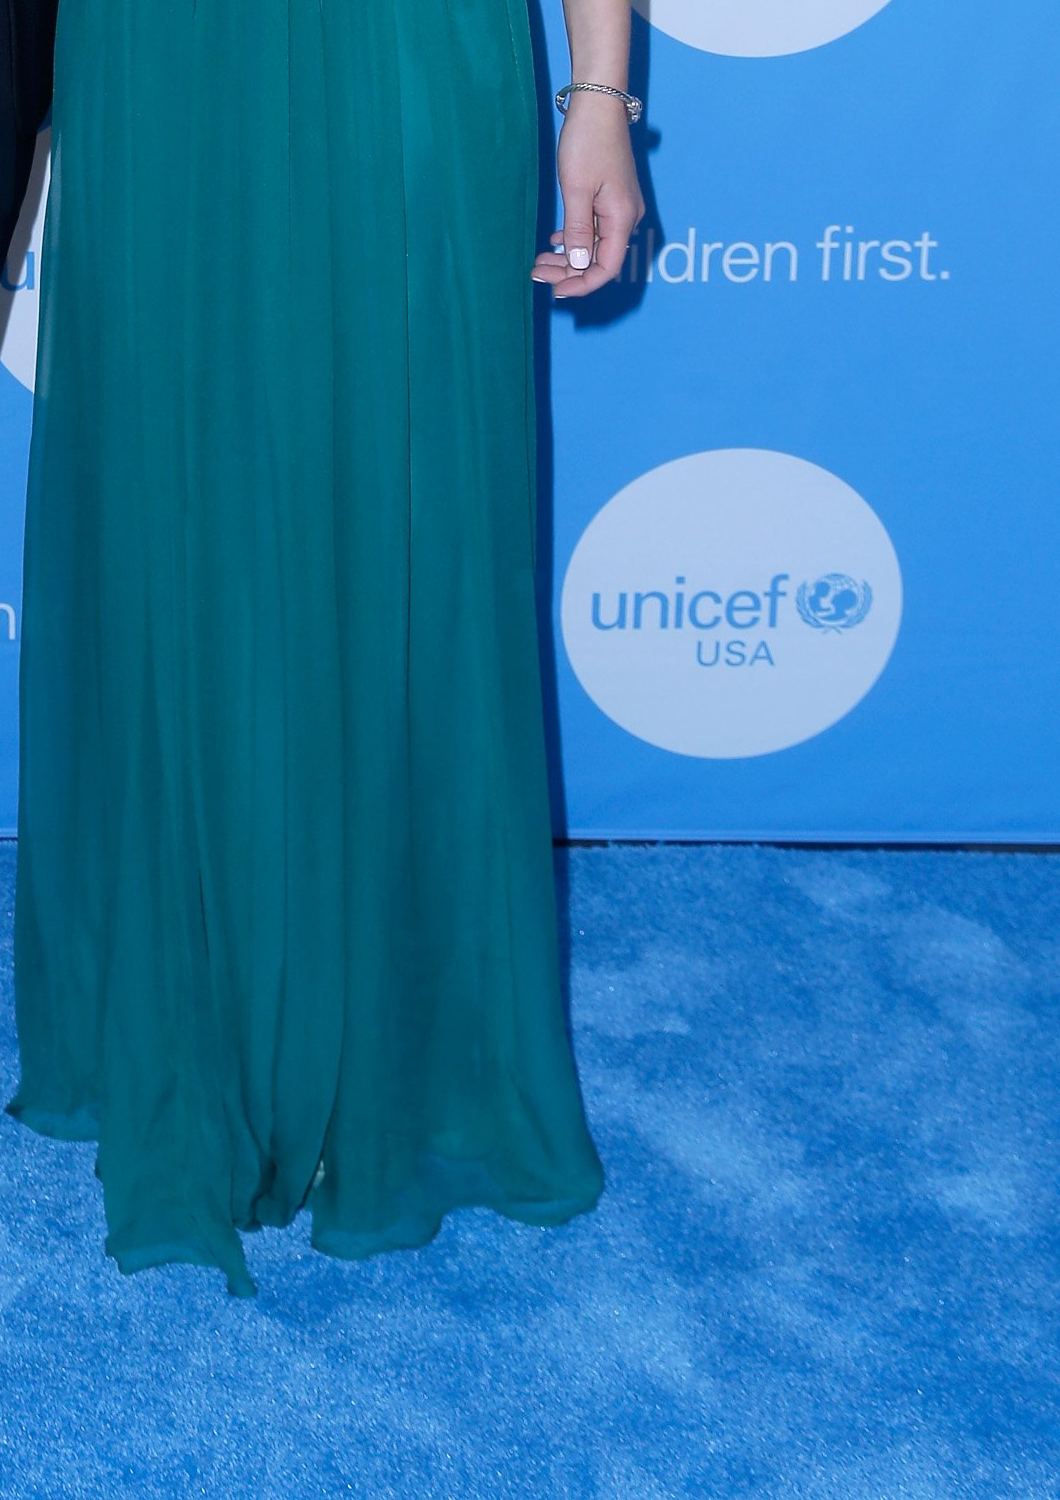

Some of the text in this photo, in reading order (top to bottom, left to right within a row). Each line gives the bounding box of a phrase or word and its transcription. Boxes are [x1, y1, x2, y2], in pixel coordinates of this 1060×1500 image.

[616, 225, 950, 283] ildren first.
[592, 574, 789, 631] unicef
[696, 640, 775, 667] USA
